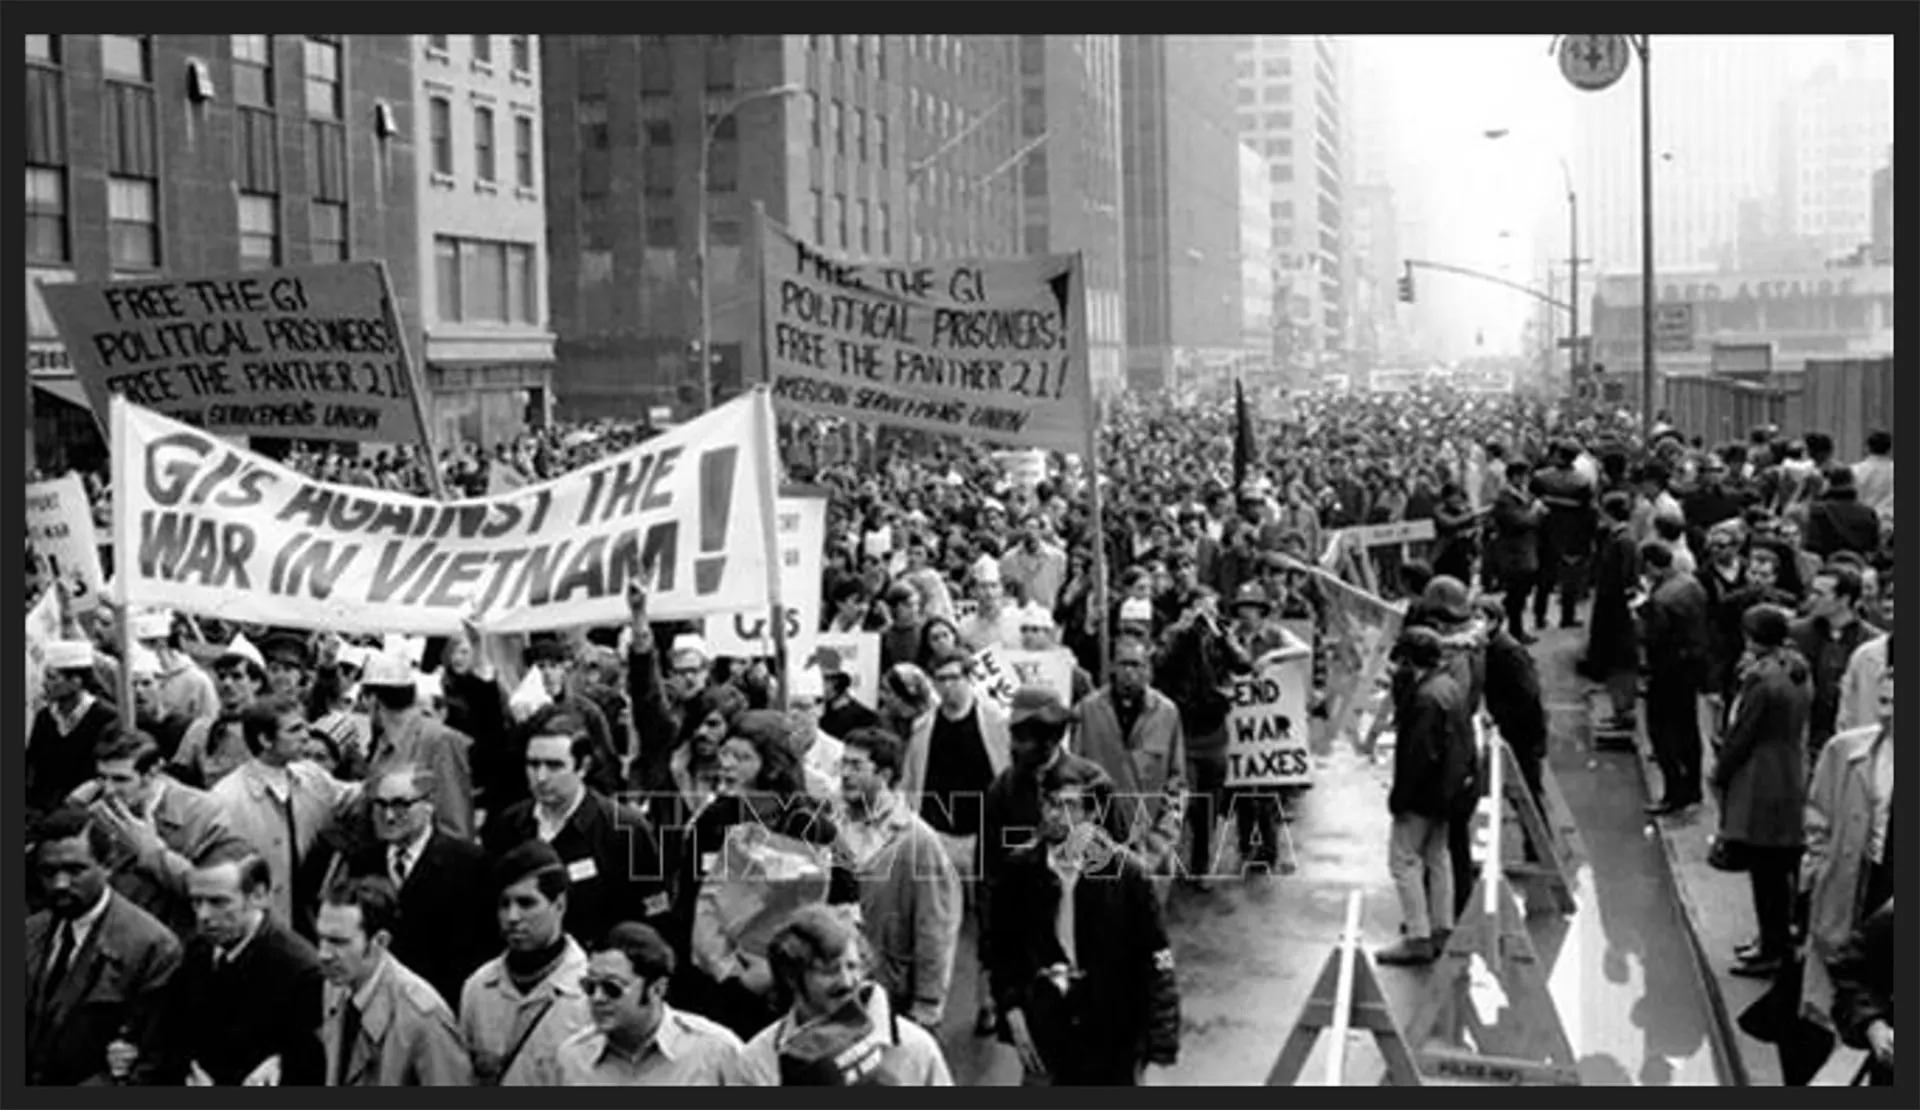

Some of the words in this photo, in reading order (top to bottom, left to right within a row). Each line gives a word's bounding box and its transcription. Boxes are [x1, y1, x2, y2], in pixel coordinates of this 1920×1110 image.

[797, 241, 862, 288] FREE
[878, 266, 935, 298] THE
[949, 266, 986, 303] GI
[103, 284, 184, 322] FREE
[185, 279, 264, 314] THE
[270, 277, 308, 311] GI
[781, 280, 916, 345] POLITICAL
[93, 319, 262, 367] POLITICAL
[776, 322, 826, 370] FREE
[840, 340, 882, 380] THE
[895, 349, 1004, 392] PANTHER
[106, 366, 181, 404] FREE
[178, 361, 237, 395] THE
[243, 359, 358, 393] PANTHER
[323, 405, 381, 430] UNION
[275, 484, 552, 539] AGAINST
[576, 444, 686, 526] THE
[138, 510, 253, 590] WAR
[269, 532, 362, 600] IN
[1233, 678, 1280, 706] END
[1235, 714, 1292, 743] WAR
[1229, 750, 1309, 779] TAXES
